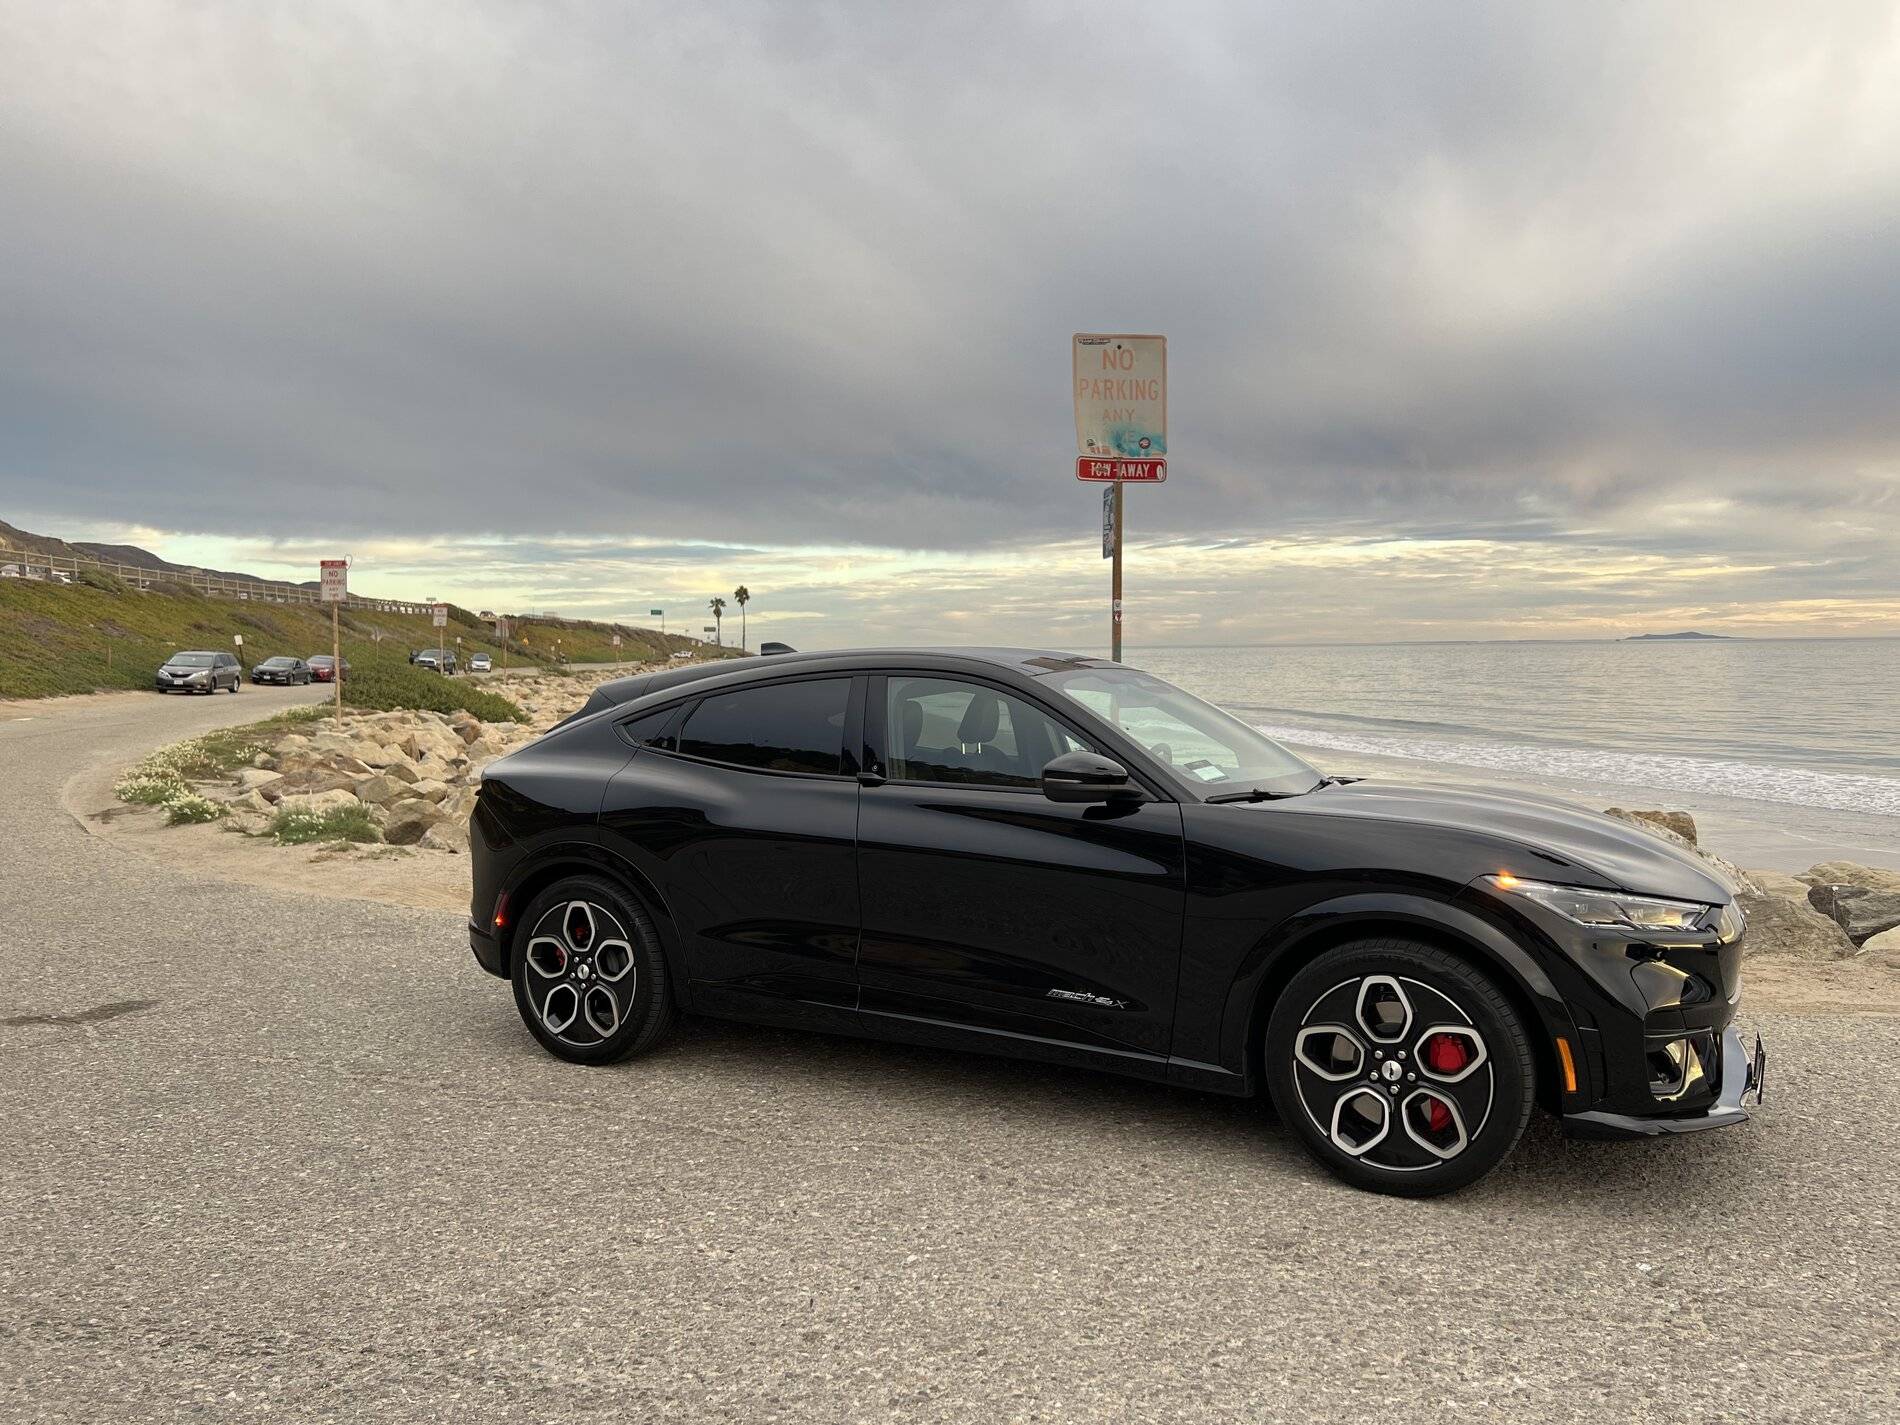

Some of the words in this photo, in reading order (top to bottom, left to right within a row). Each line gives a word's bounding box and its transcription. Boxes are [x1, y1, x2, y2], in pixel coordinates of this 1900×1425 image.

[1103, 350, 1134, 371] NO
[1079, 378, 1159, 401] PARKING
[1103, 408, 1136, 422] ANY
